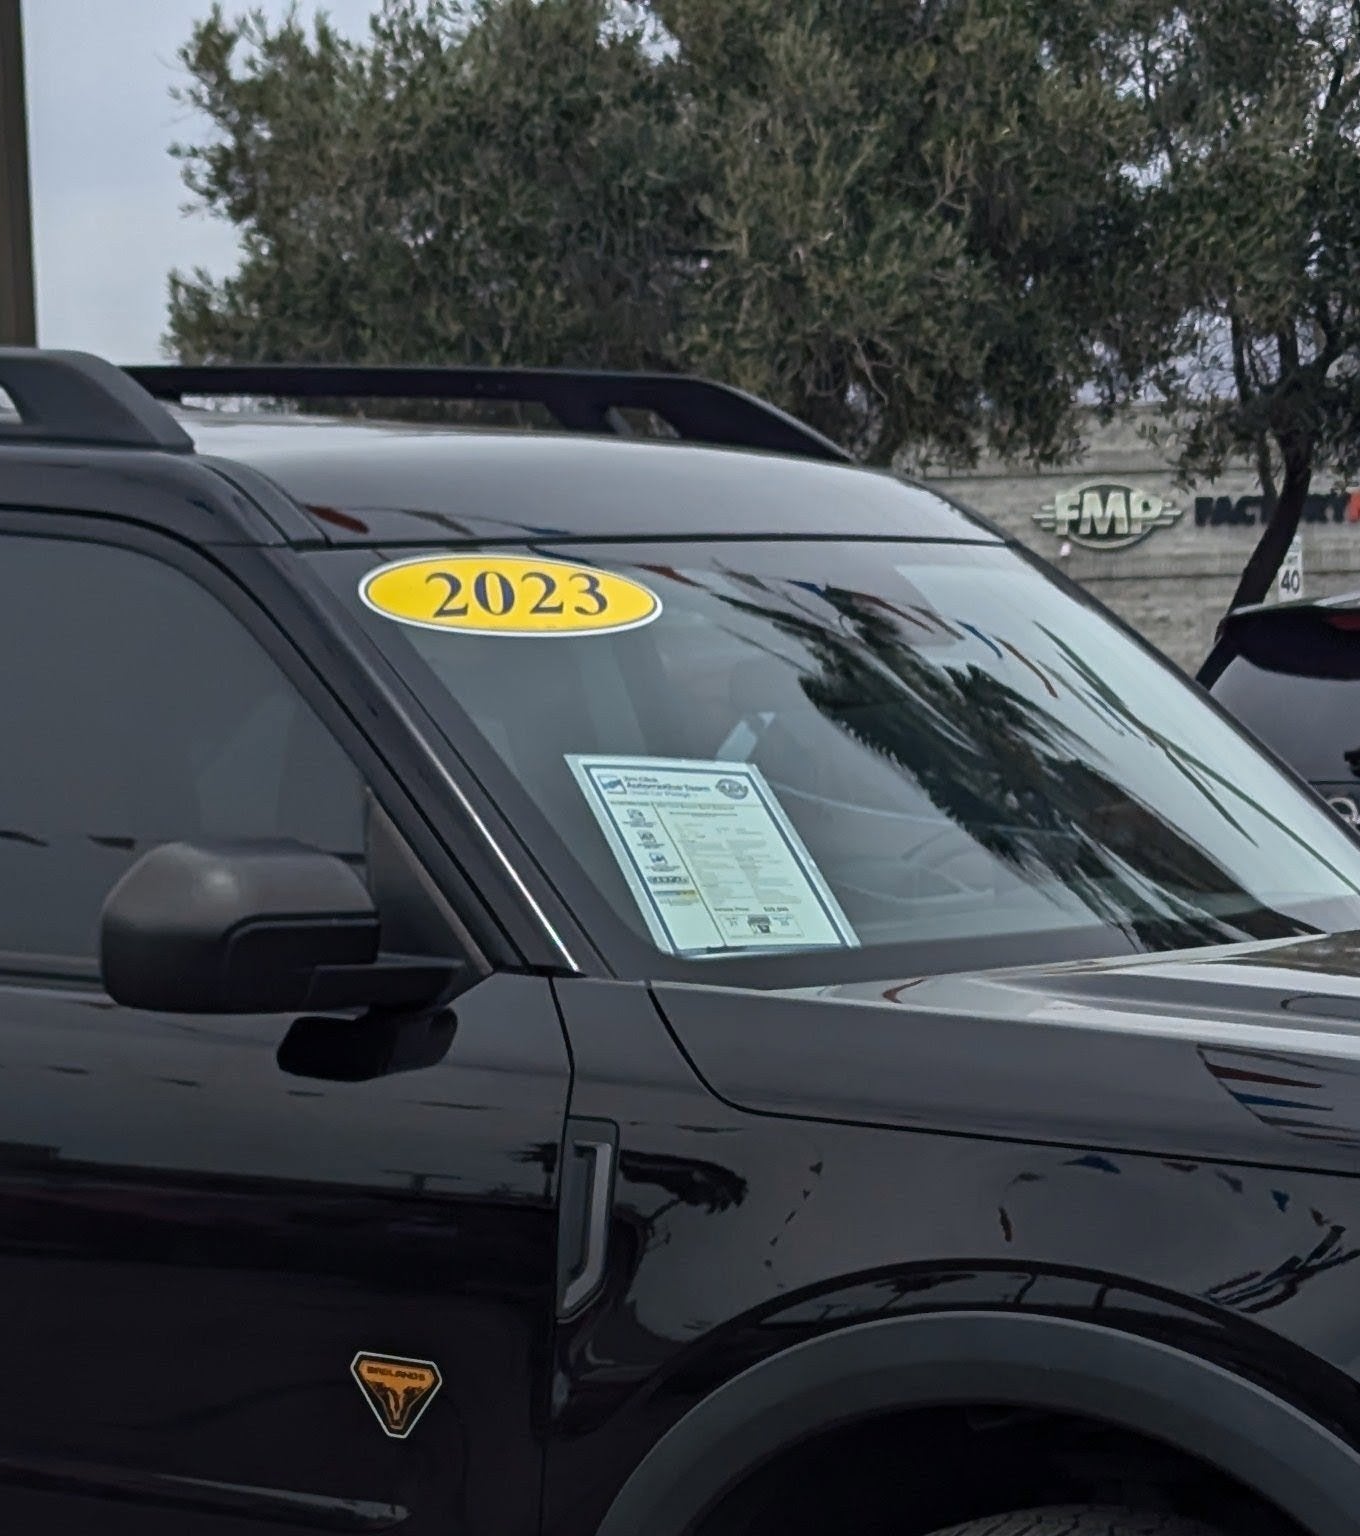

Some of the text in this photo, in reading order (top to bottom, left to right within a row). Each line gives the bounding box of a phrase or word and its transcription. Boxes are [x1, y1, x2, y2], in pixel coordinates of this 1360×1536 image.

[1054, 491, 1163, 536] FMP
[1195, 493, 1349, 526] FACTRY
[424, 570, 609, 618] 2023
[1280, 569, 1301, 595] 40
